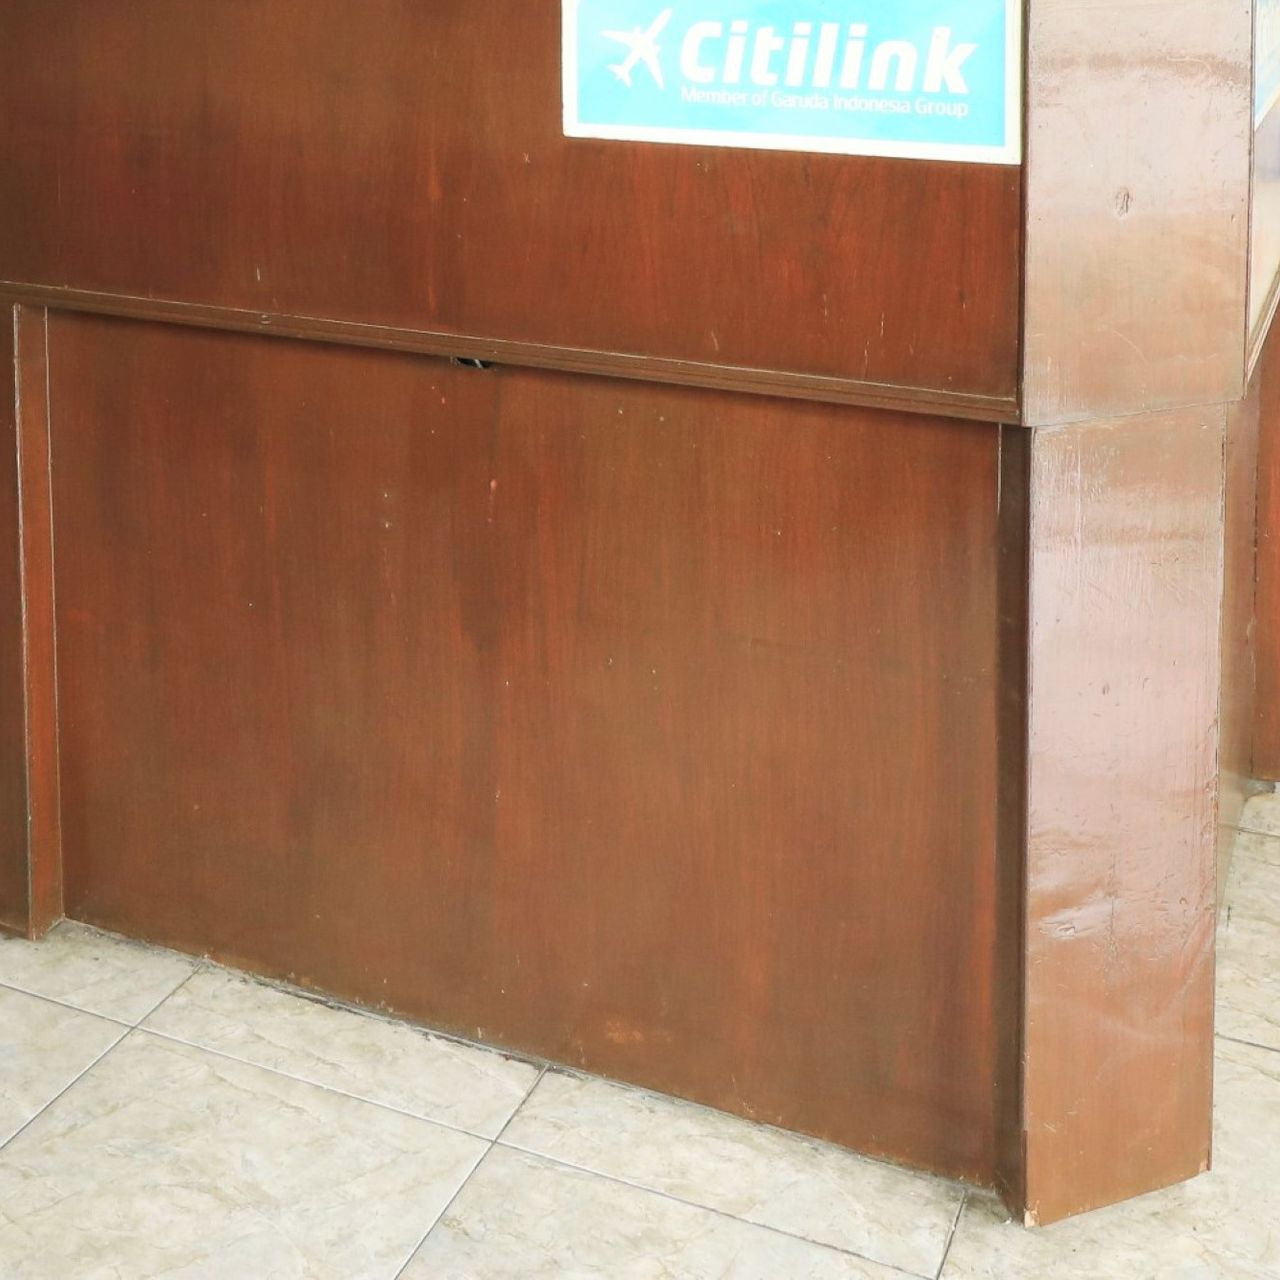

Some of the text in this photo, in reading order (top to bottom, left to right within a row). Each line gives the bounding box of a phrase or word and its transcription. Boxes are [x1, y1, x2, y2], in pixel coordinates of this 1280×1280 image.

[679, 20, 980, 95] Citilink
[679, 86, 969, 118] Member of Garuda Indonesia Group
